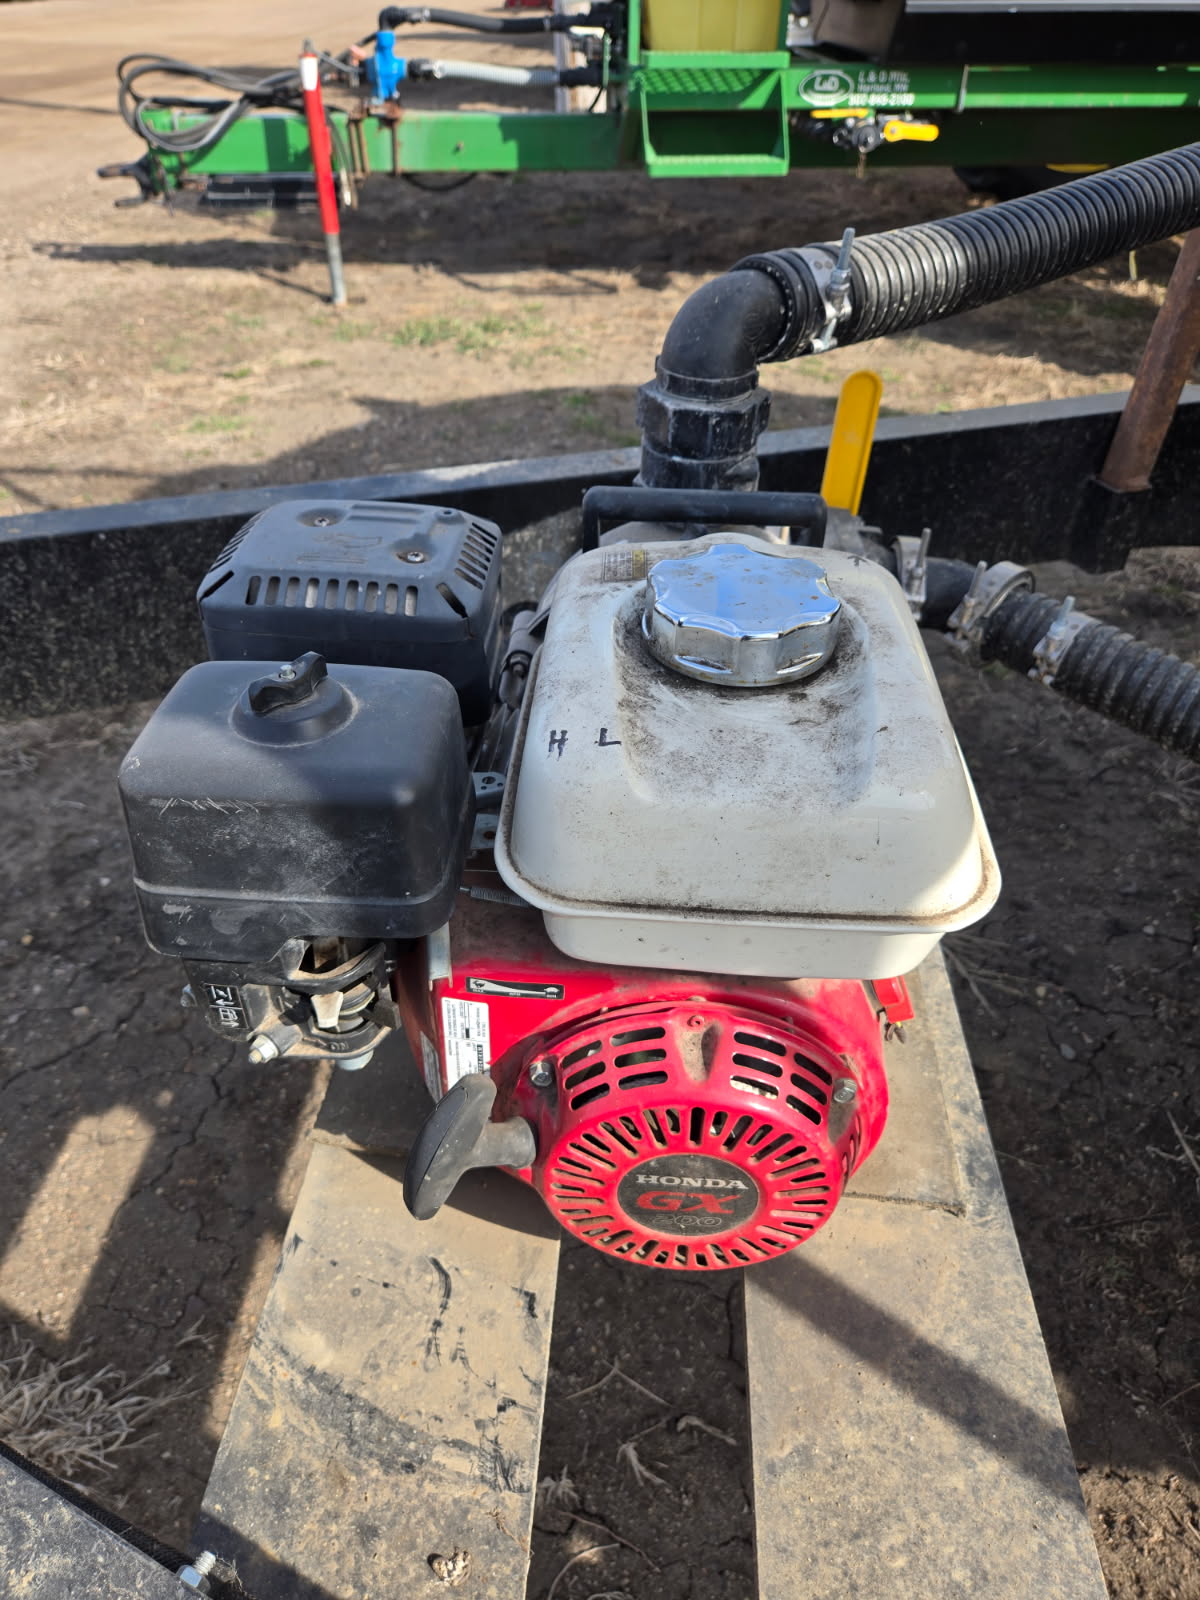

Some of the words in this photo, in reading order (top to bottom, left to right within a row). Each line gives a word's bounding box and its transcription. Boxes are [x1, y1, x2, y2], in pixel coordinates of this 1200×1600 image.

[548, 730, 568, 758] H
[598, 728, 622, 746] L
[636, 1174, 749, 1190] HONDA
[636, 1190, 743, 1214] GX
[652, 1213, 722, 1227] 200
